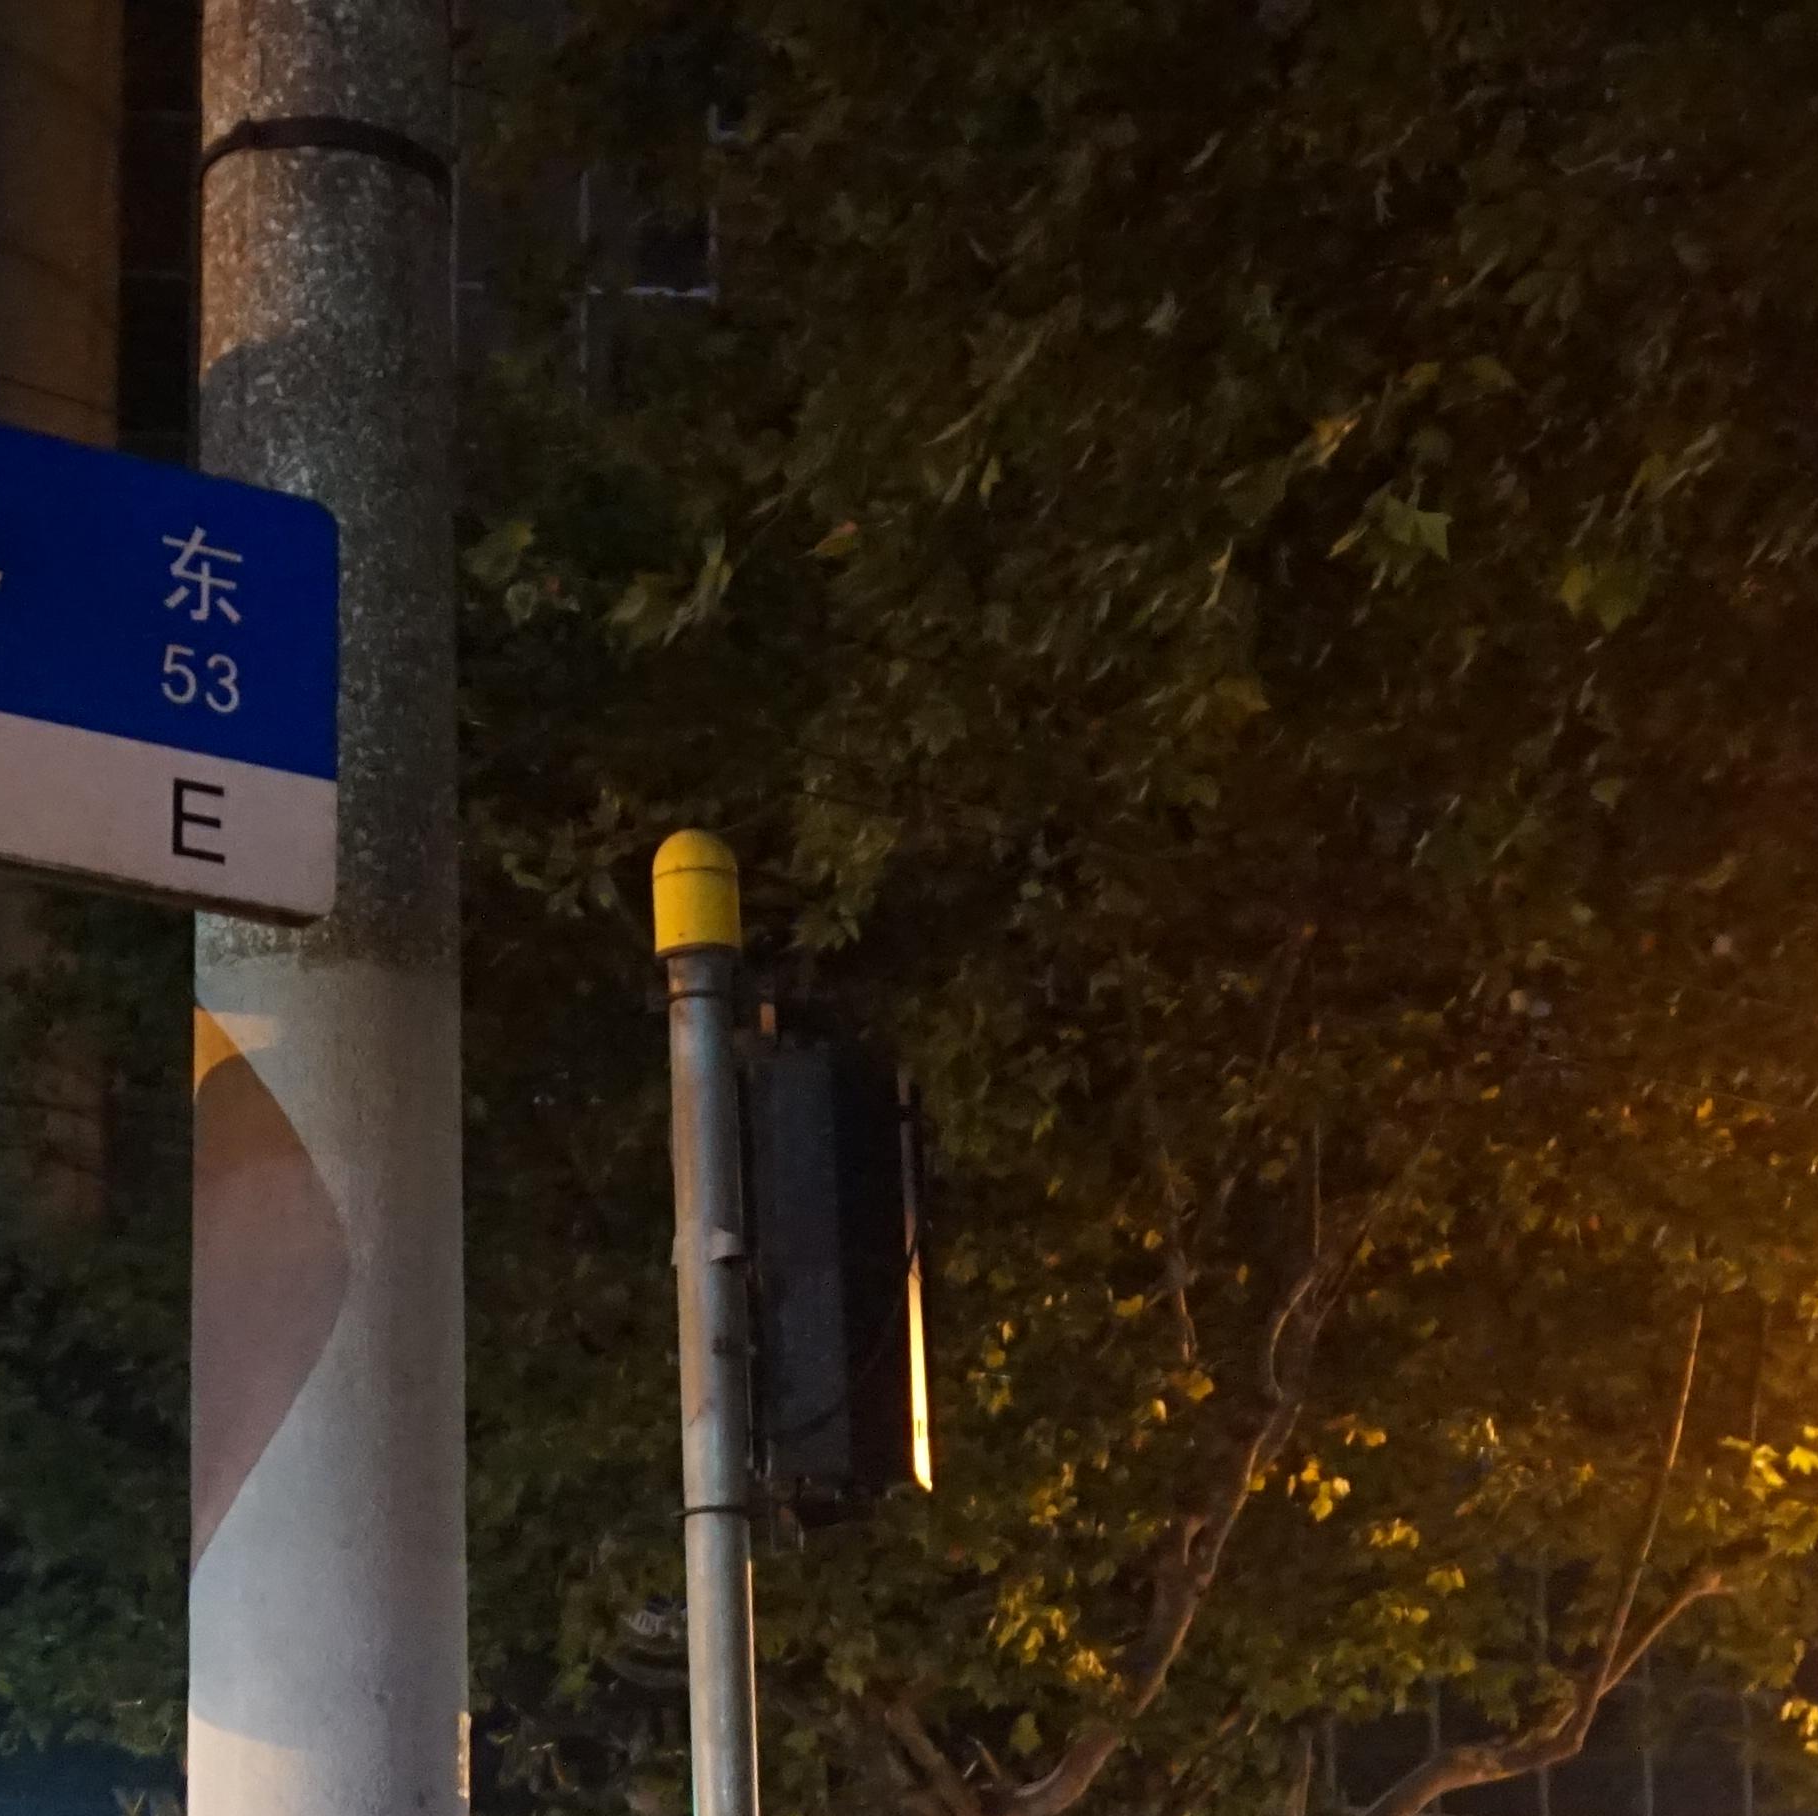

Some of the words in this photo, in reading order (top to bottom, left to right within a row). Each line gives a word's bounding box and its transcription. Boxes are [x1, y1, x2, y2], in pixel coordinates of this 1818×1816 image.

[161, 526, 243, 624] 东
[161, 644, 241, 714] 53
[172, 777, 226, 865] E
